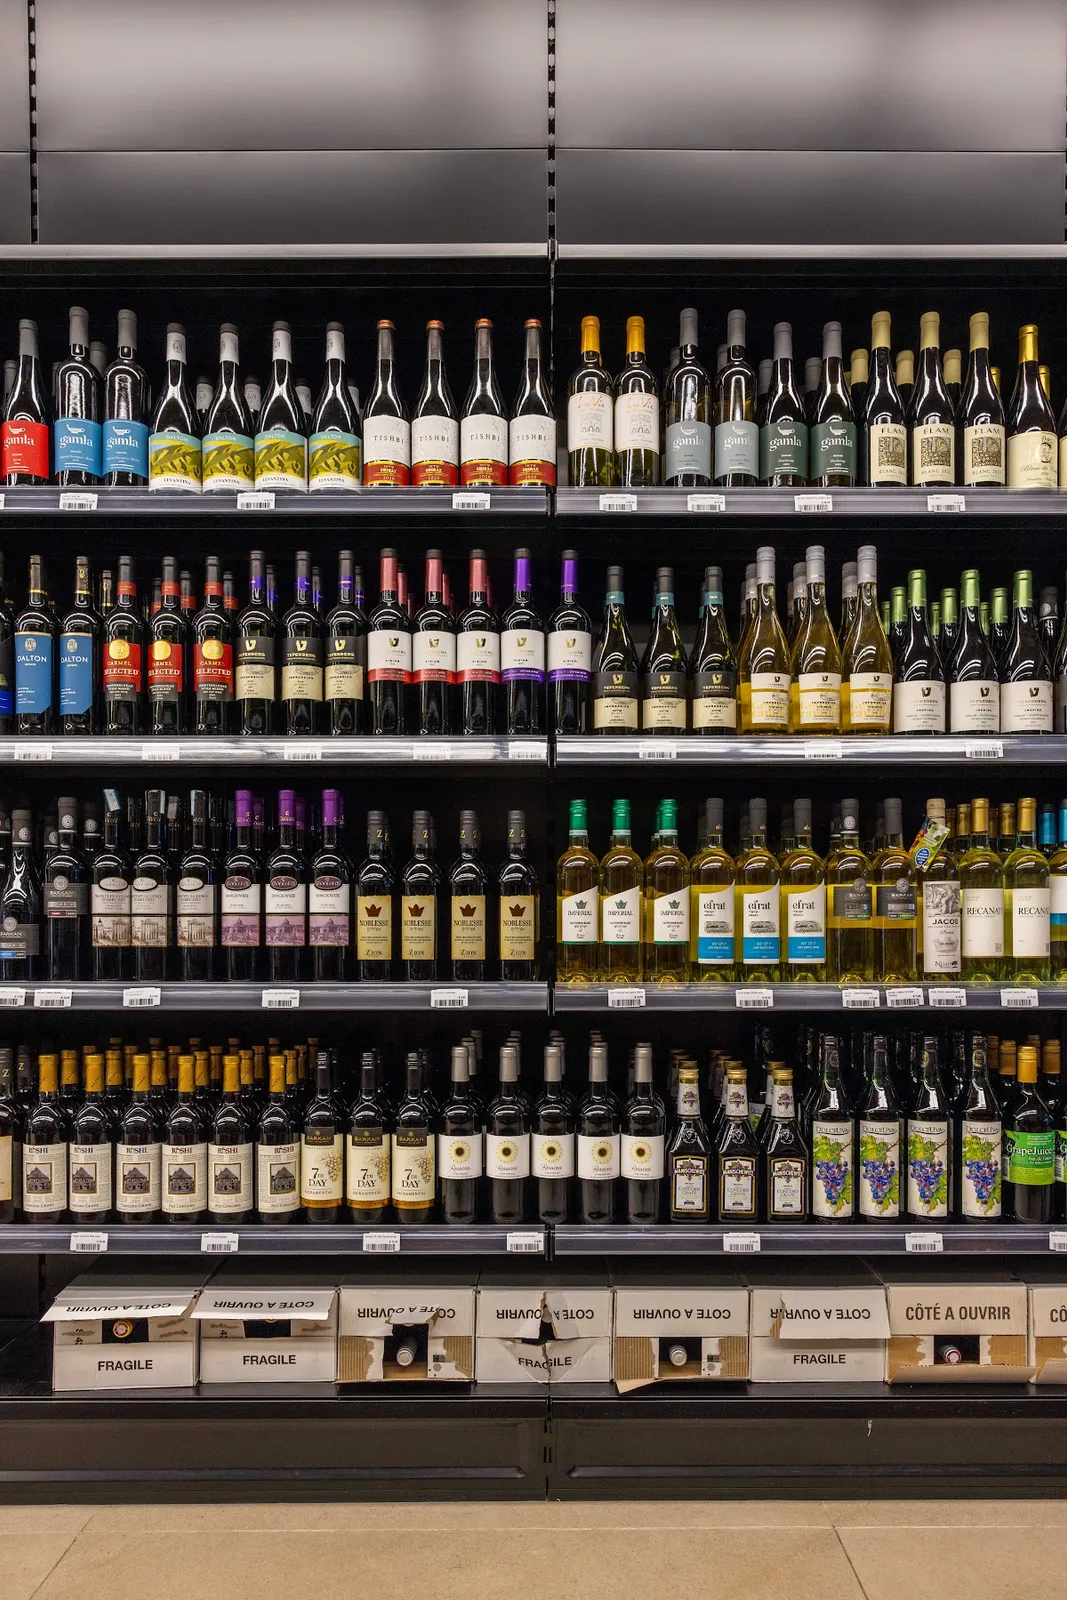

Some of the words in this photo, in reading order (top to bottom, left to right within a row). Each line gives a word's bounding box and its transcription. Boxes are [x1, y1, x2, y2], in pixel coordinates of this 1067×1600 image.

[4, 434, 35, 450] gamla
[60, 435, 93, 449] gamla
[106, 435, 139, 450] gamla
[373, 434, 404, 445] TISHBI
[419, 434, 450, 443] TISHBI
[470, 433, 500, 442] TISHBI
[516, 434, 547, 442] TISHBI
[672, 436, 704, 452] gamla
[769, 435, 802, 452] gamla
[820, 435, 853, 452] gamla
[61, 656, 88, 664] DALTON
[104, 668, 139, 676] SELECTED
[196, 668, 232, 676] SELECTED
[703, 900, 726, 910] efrat
[748, 900, 771, 910] efrat
[792, 900, 815, 910] efrat
[18, 1062, 24, 1070] Z
[2, 1068, 10, 1078] Z
[674, 1168, 706, 1177] MANISCHEWITZ
[723, 1169, 754, 1177] MANISCHEWITZ
[773, 1170, 803, 1178] MANISCHEWITZ
[308, 1179, 328, 1187] DAY
[357, 1180, 377, 1188] DAY
[401, 1180, 421, 1188] DAY
[278, 1300, 314, 1308] COTE
[563, 1308, 595, 1319] COTE
[633, 1309, 681, 1319] OUVRIR
[684, 1309, 693, 1319] A
[696, 1309, 731, 1319] COTE
[770, 1308, 820, 1320] OUVRIR
[824, 1310, 832, 1319] A
[836, 1308, 871, 1319] COTE
[905, 1303, 940, 1320] CÔTÉ
[945, 1306, 954, 1320] A
[959, 1306, 1010, 1320] OUVRIR
[1050, 1305, 1067, 1322] CÔ
[243, 1354, 296, 1365] FRAGILE
[518, 1356, 572, 1370] FRAGILE
[793, 1354, 846, 1365] FRAGILE
[98, 1360, 153, 1372] FRAGILE
